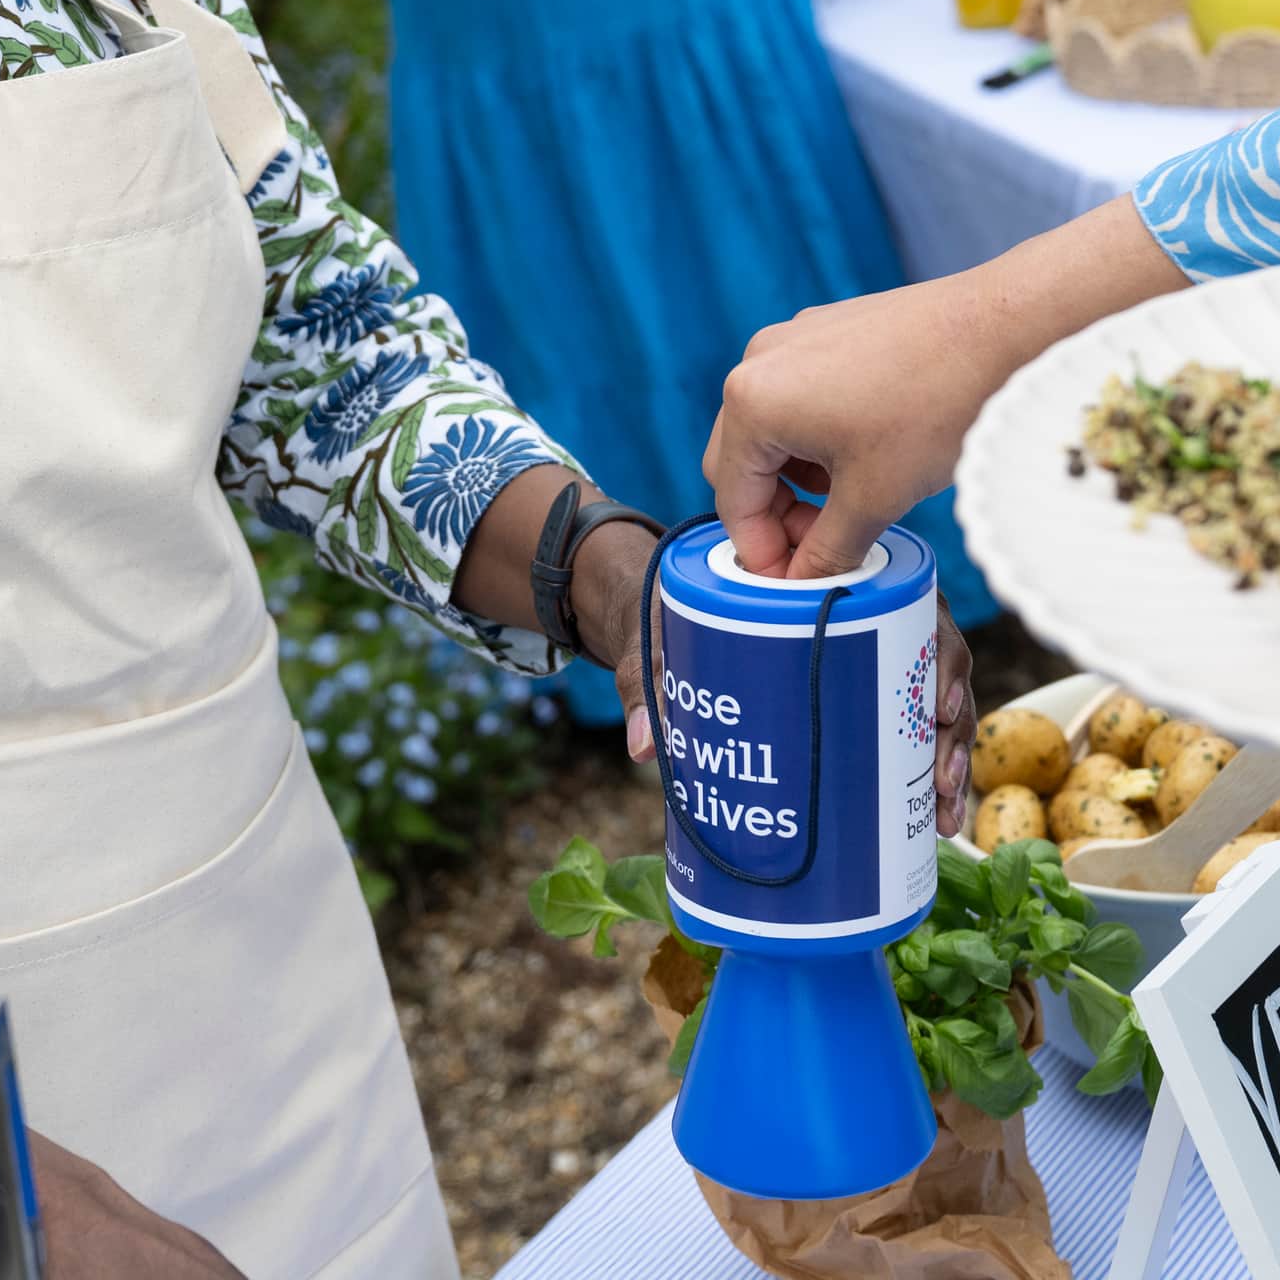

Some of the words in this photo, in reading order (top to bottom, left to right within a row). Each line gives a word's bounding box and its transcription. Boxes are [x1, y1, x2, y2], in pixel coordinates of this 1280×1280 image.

[692, 738, 778, 785] will
[693, 780, 799, 839] lives
[906, 786, 935, 816] Toge
